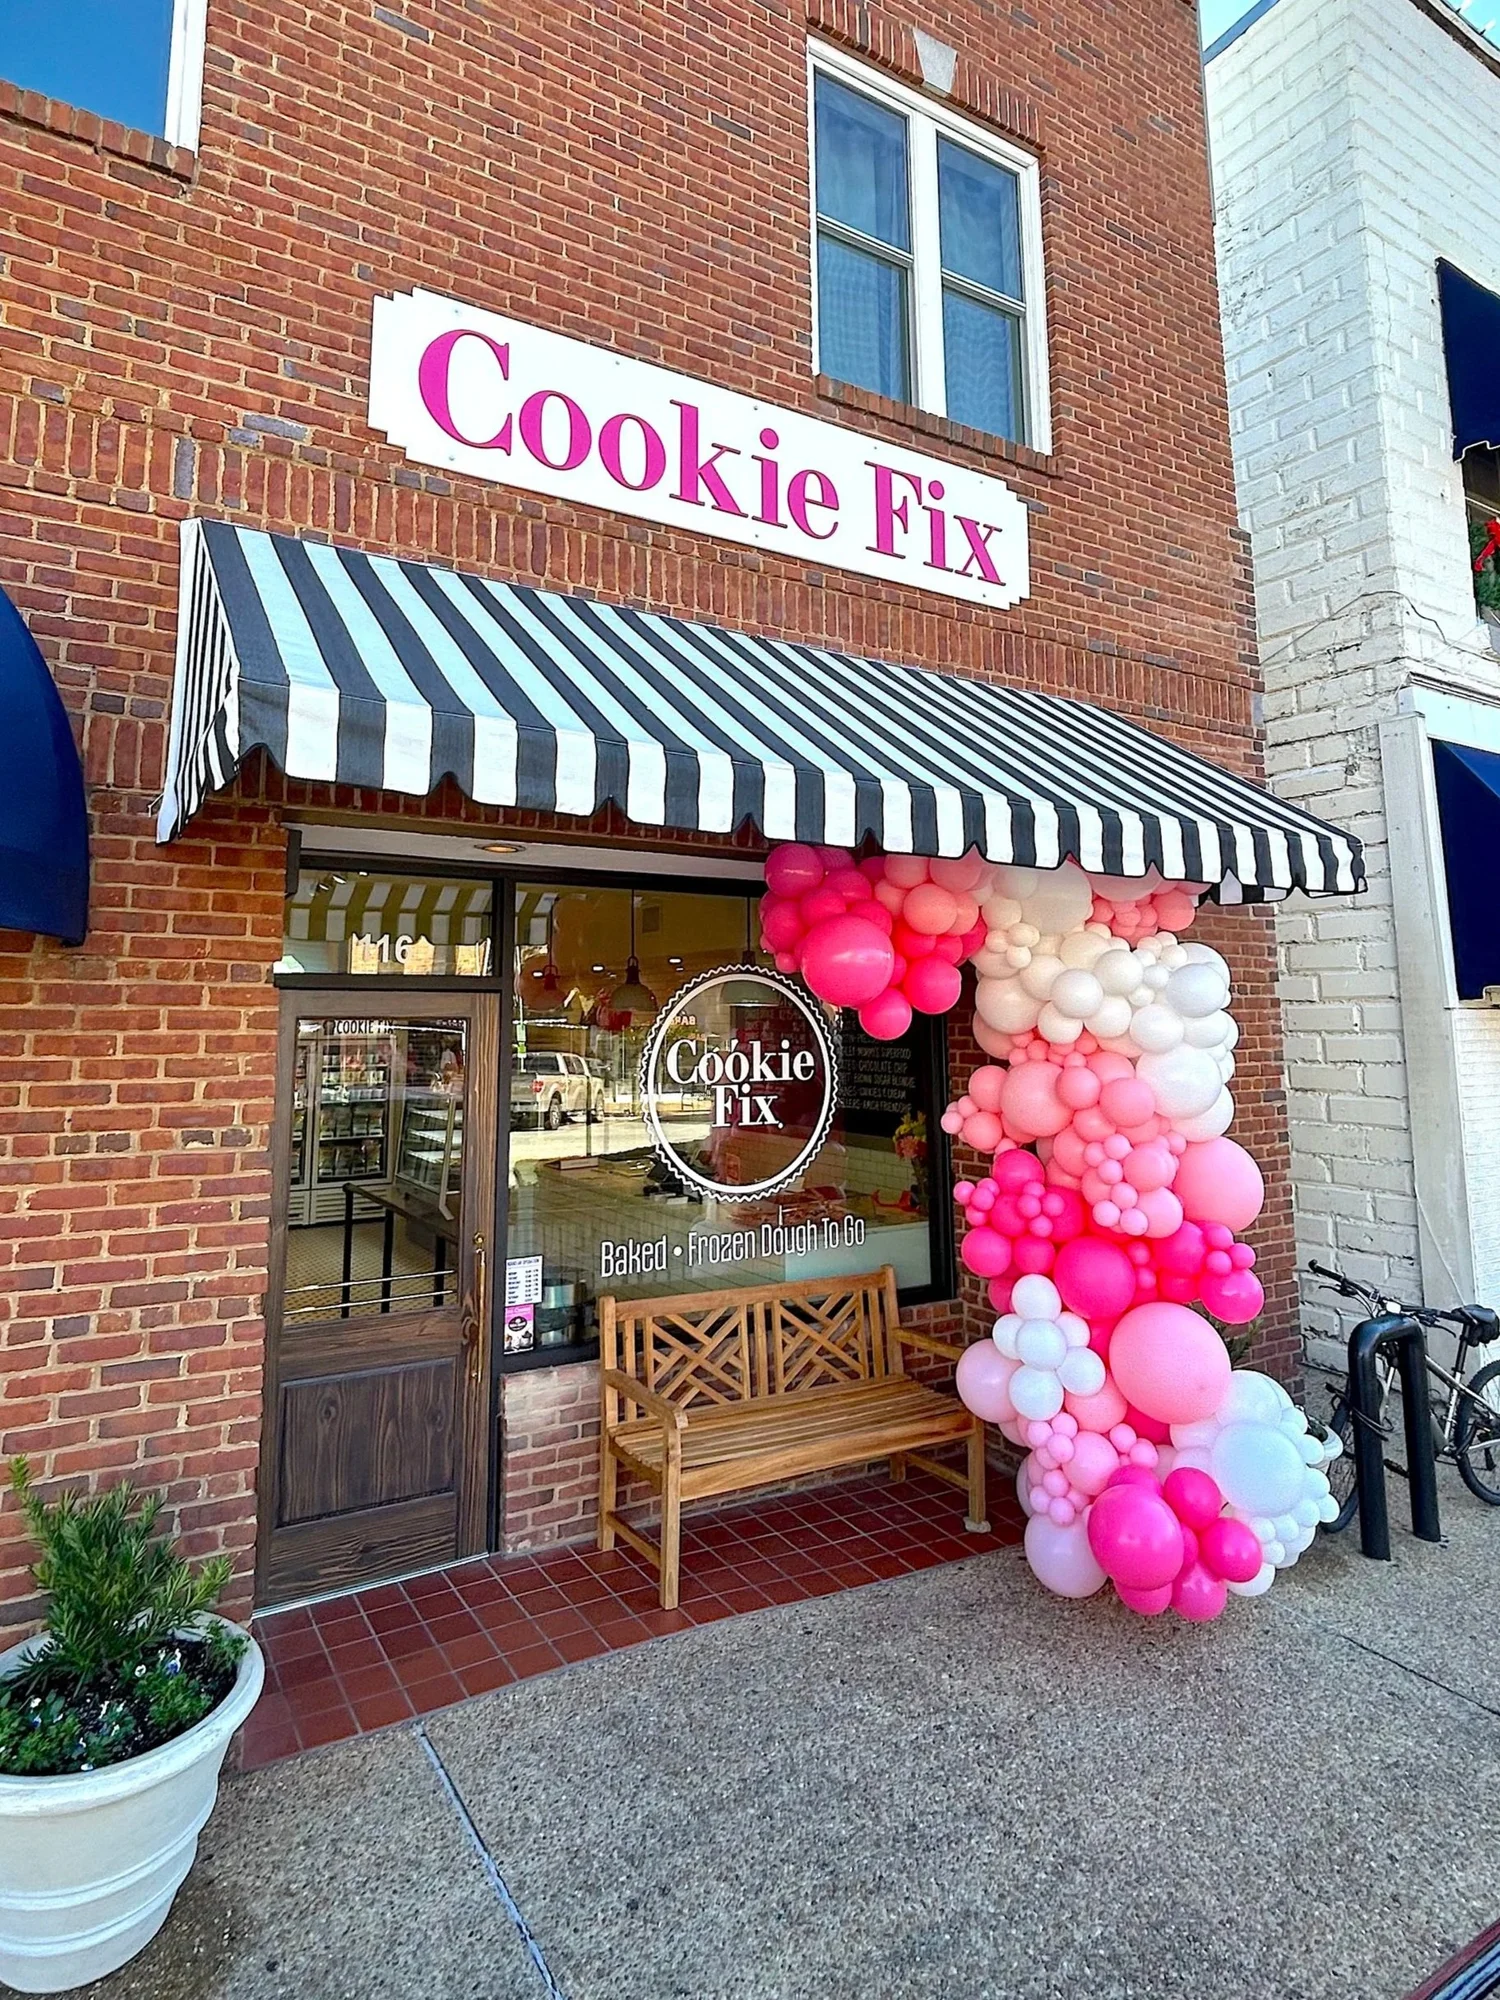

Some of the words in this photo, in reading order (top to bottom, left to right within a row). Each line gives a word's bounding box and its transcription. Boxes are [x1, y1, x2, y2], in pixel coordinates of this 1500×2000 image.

[418, 328, 840, 540] Cookie
[864, 461, 1006, 587] Fix
[357, 933, 413, 964] 116
[336, 1020, 374, 1035] COOKIE
[666, 1039, 815, 1085] Cookie
[601, 1236, 667, 1278] Baked
[688, 1230, 756, 1267] Frozen
[761, 1218, 818, 1257] Dough
[821, 1217, 839, 1249] To
[844, 1214, 865, 1247] Go
